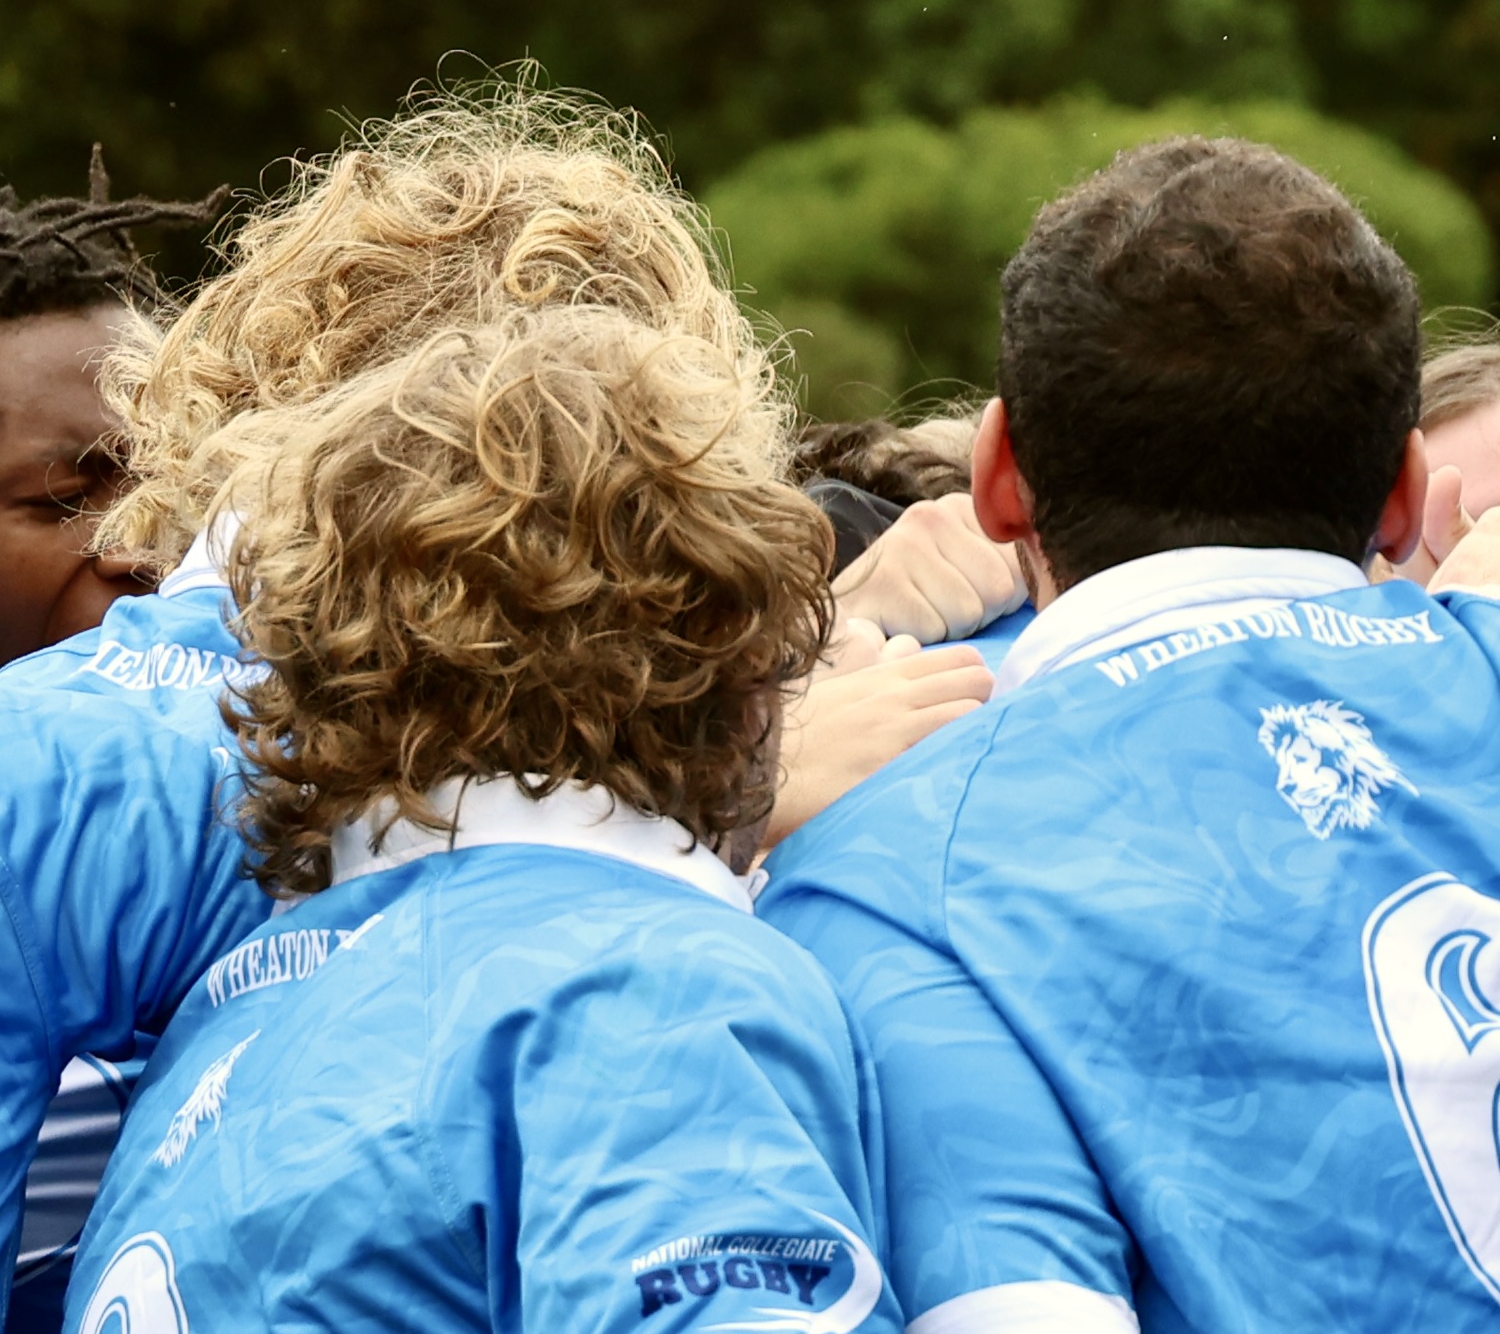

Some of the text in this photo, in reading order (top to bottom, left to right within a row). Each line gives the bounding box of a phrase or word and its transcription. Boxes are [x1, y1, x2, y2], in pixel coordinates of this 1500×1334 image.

[1094, 601, 1445, 688] WHEATON RUGBY
[207, 929, 331, 1008] WHEATON
[631, 1235, 840, 1273] NATIONAL COLLEGIATE
[635, 1256, 832, 1319] RUGBY
